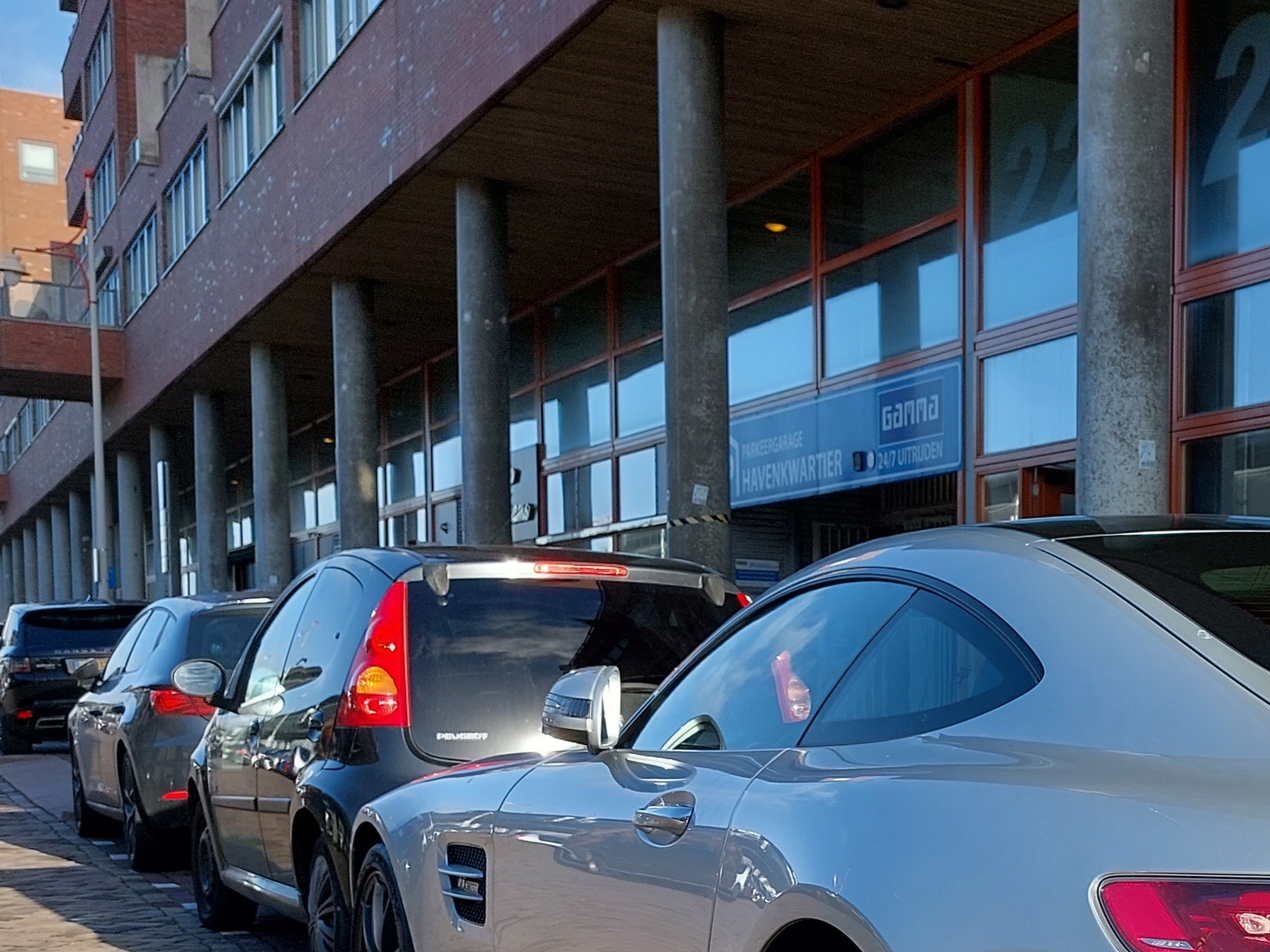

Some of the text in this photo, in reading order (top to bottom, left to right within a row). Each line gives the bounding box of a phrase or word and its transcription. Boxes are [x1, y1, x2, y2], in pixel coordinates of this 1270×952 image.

[742, 431, 804, 458] PARKEERGARAGE
[742, 449, 843, 493] HAVENKWARTIER
[878, 450, 897, 470] 24/7
